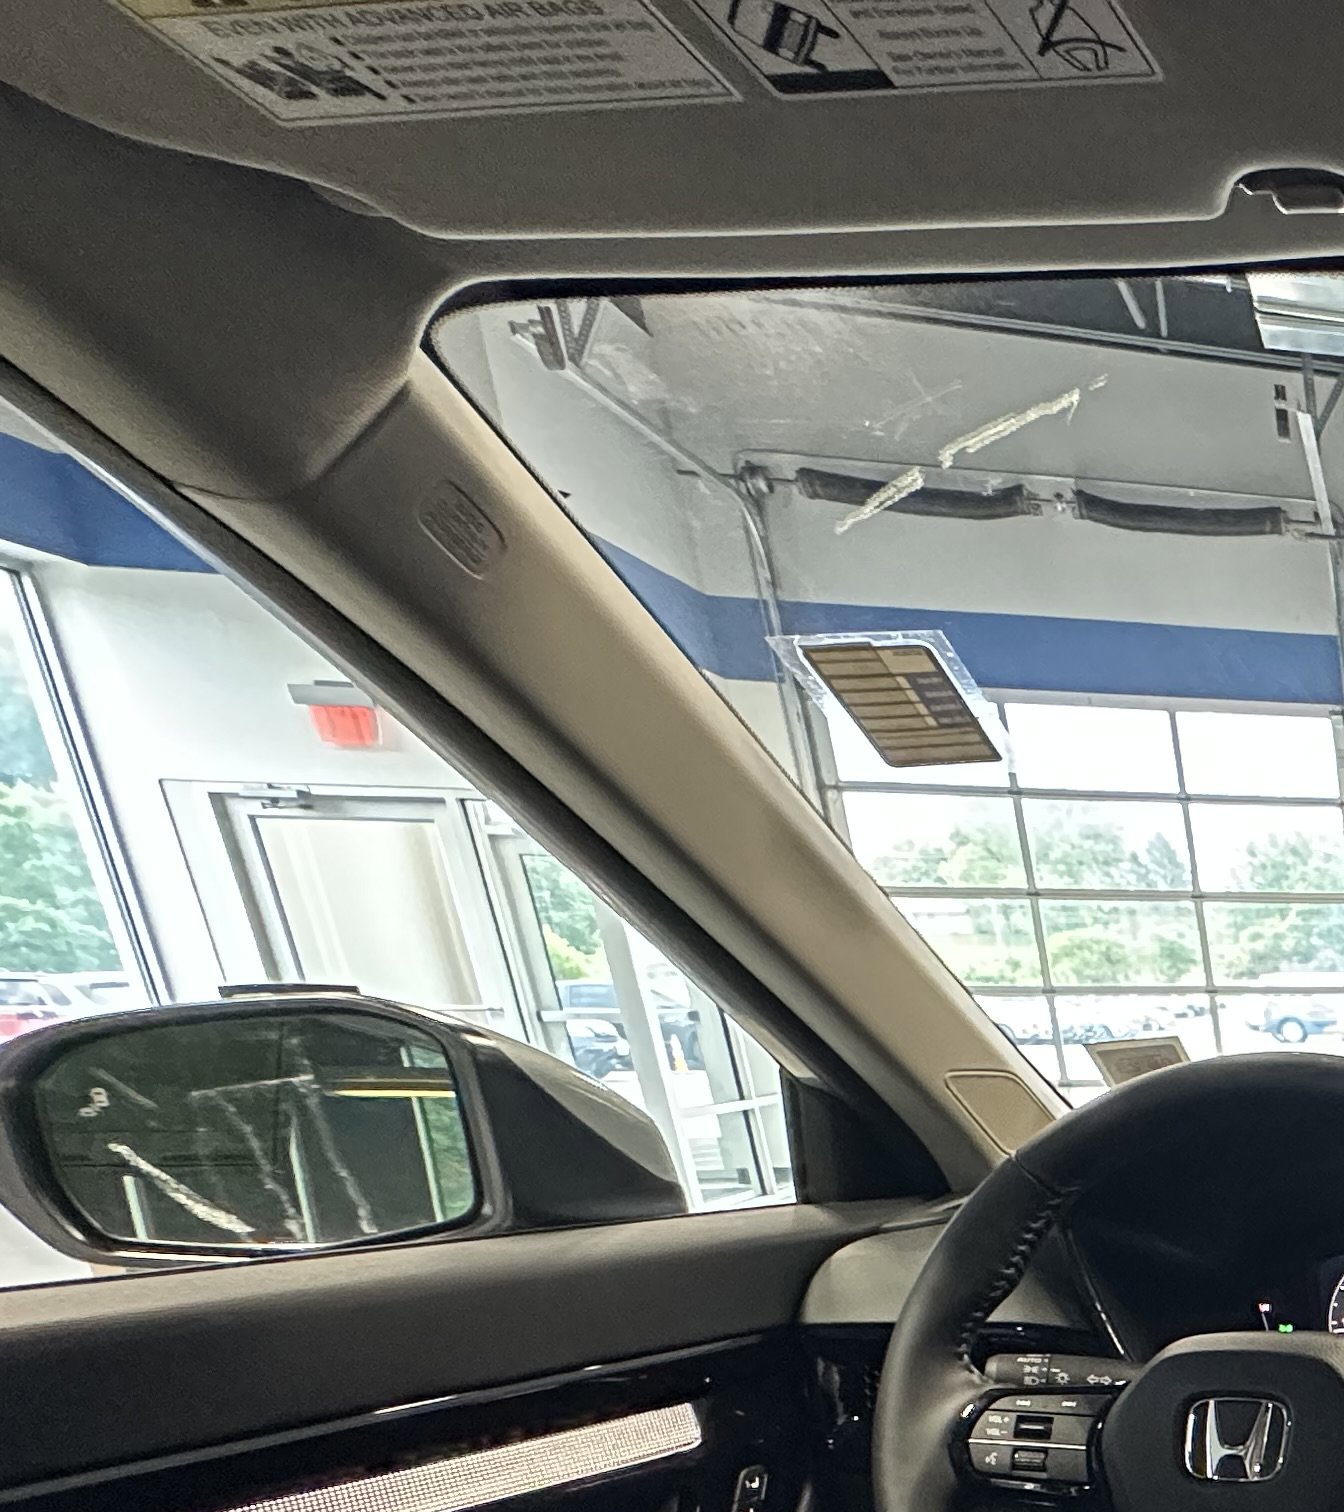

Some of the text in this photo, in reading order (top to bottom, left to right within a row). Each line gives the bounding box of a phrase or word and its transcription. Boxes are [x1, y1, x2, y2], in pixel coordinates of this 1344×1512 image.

[272, 13, 349, 33] WITH
[346, 4, 485, 27] ADVANCED
[484, 2, 532, 19] AIR
